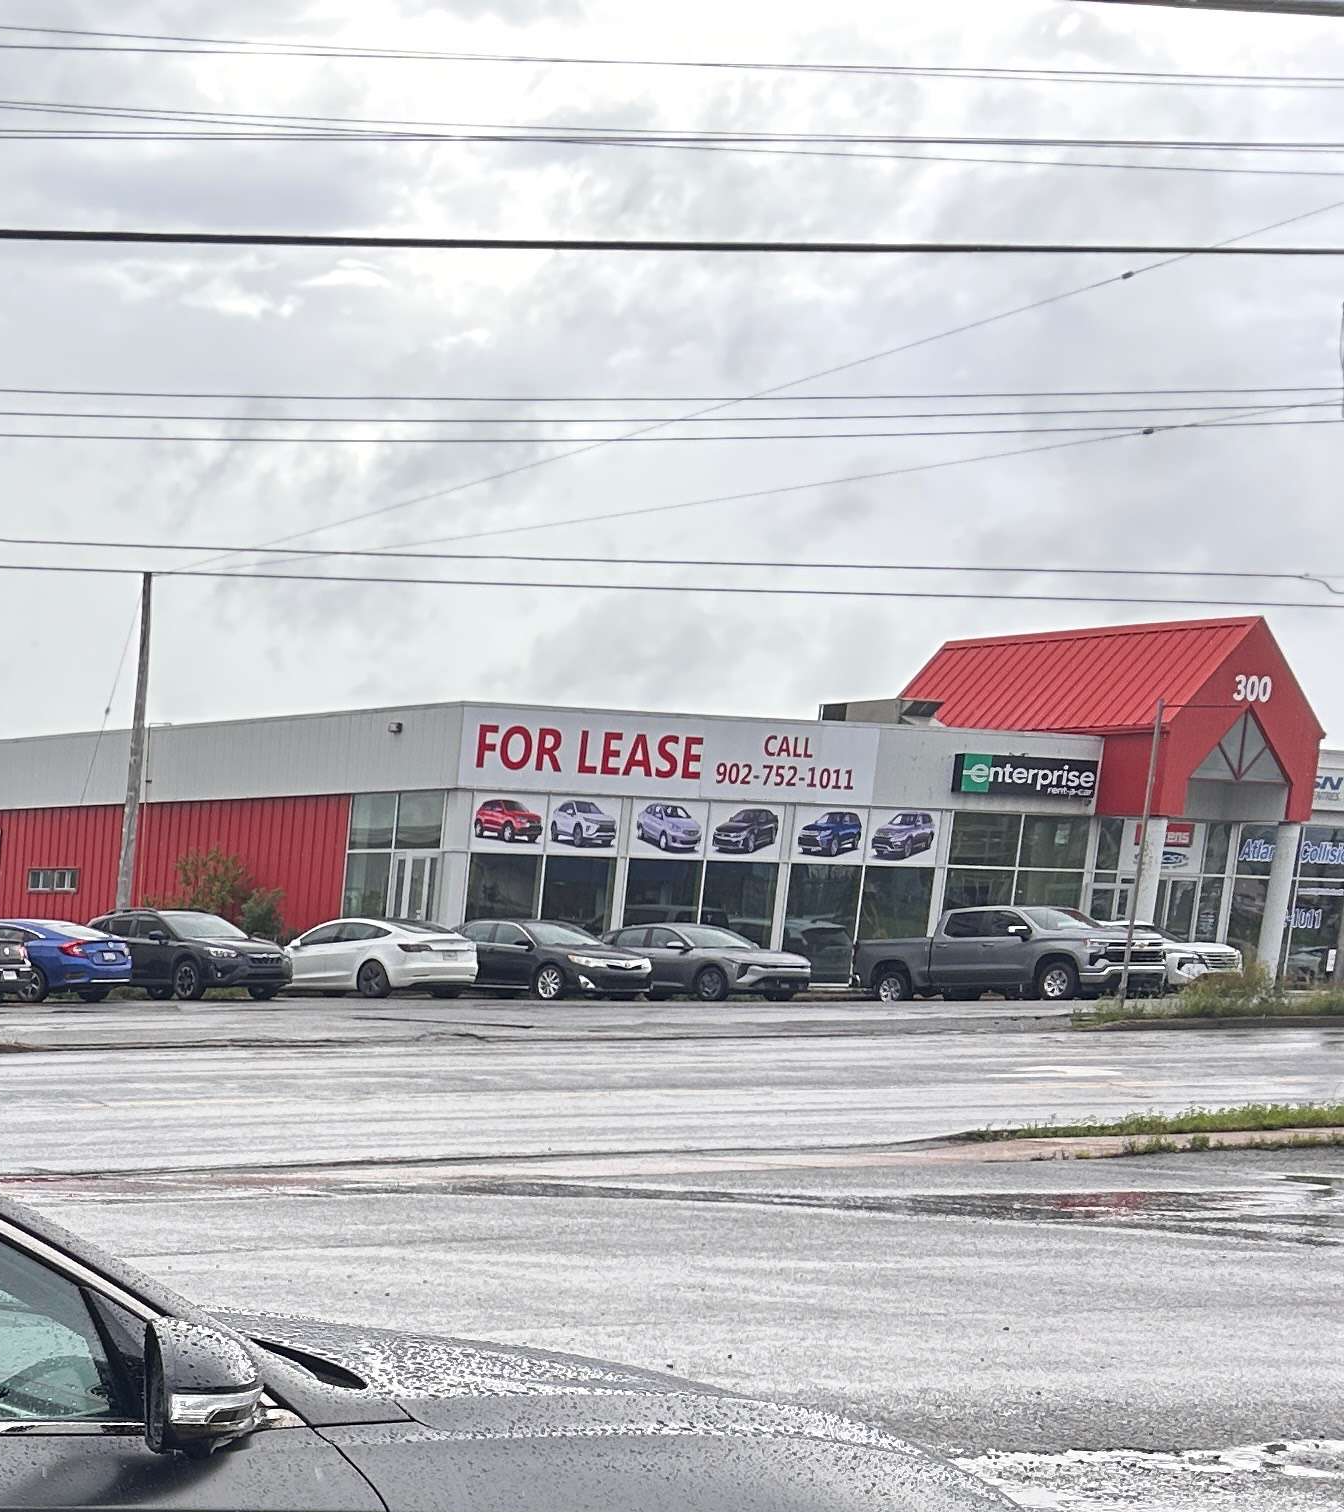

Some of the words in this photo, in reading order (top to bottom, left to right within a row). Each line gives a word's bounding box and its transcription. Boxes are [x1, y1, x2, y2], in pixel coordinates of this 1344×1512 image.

[1232, 674, 1272, 703] 300
[474, 723, 563, 773] FOR
[576, 729, 705, 780] LEASE
[763, 734, 814, 759] CALL
[715, 761, 855, 791] 902-752-1011
[964, 763, 1096, 791] enterprise
[1047, 785, 1094, 797] rent-a-car
[1300, 840, 1344, 864] Collisi
